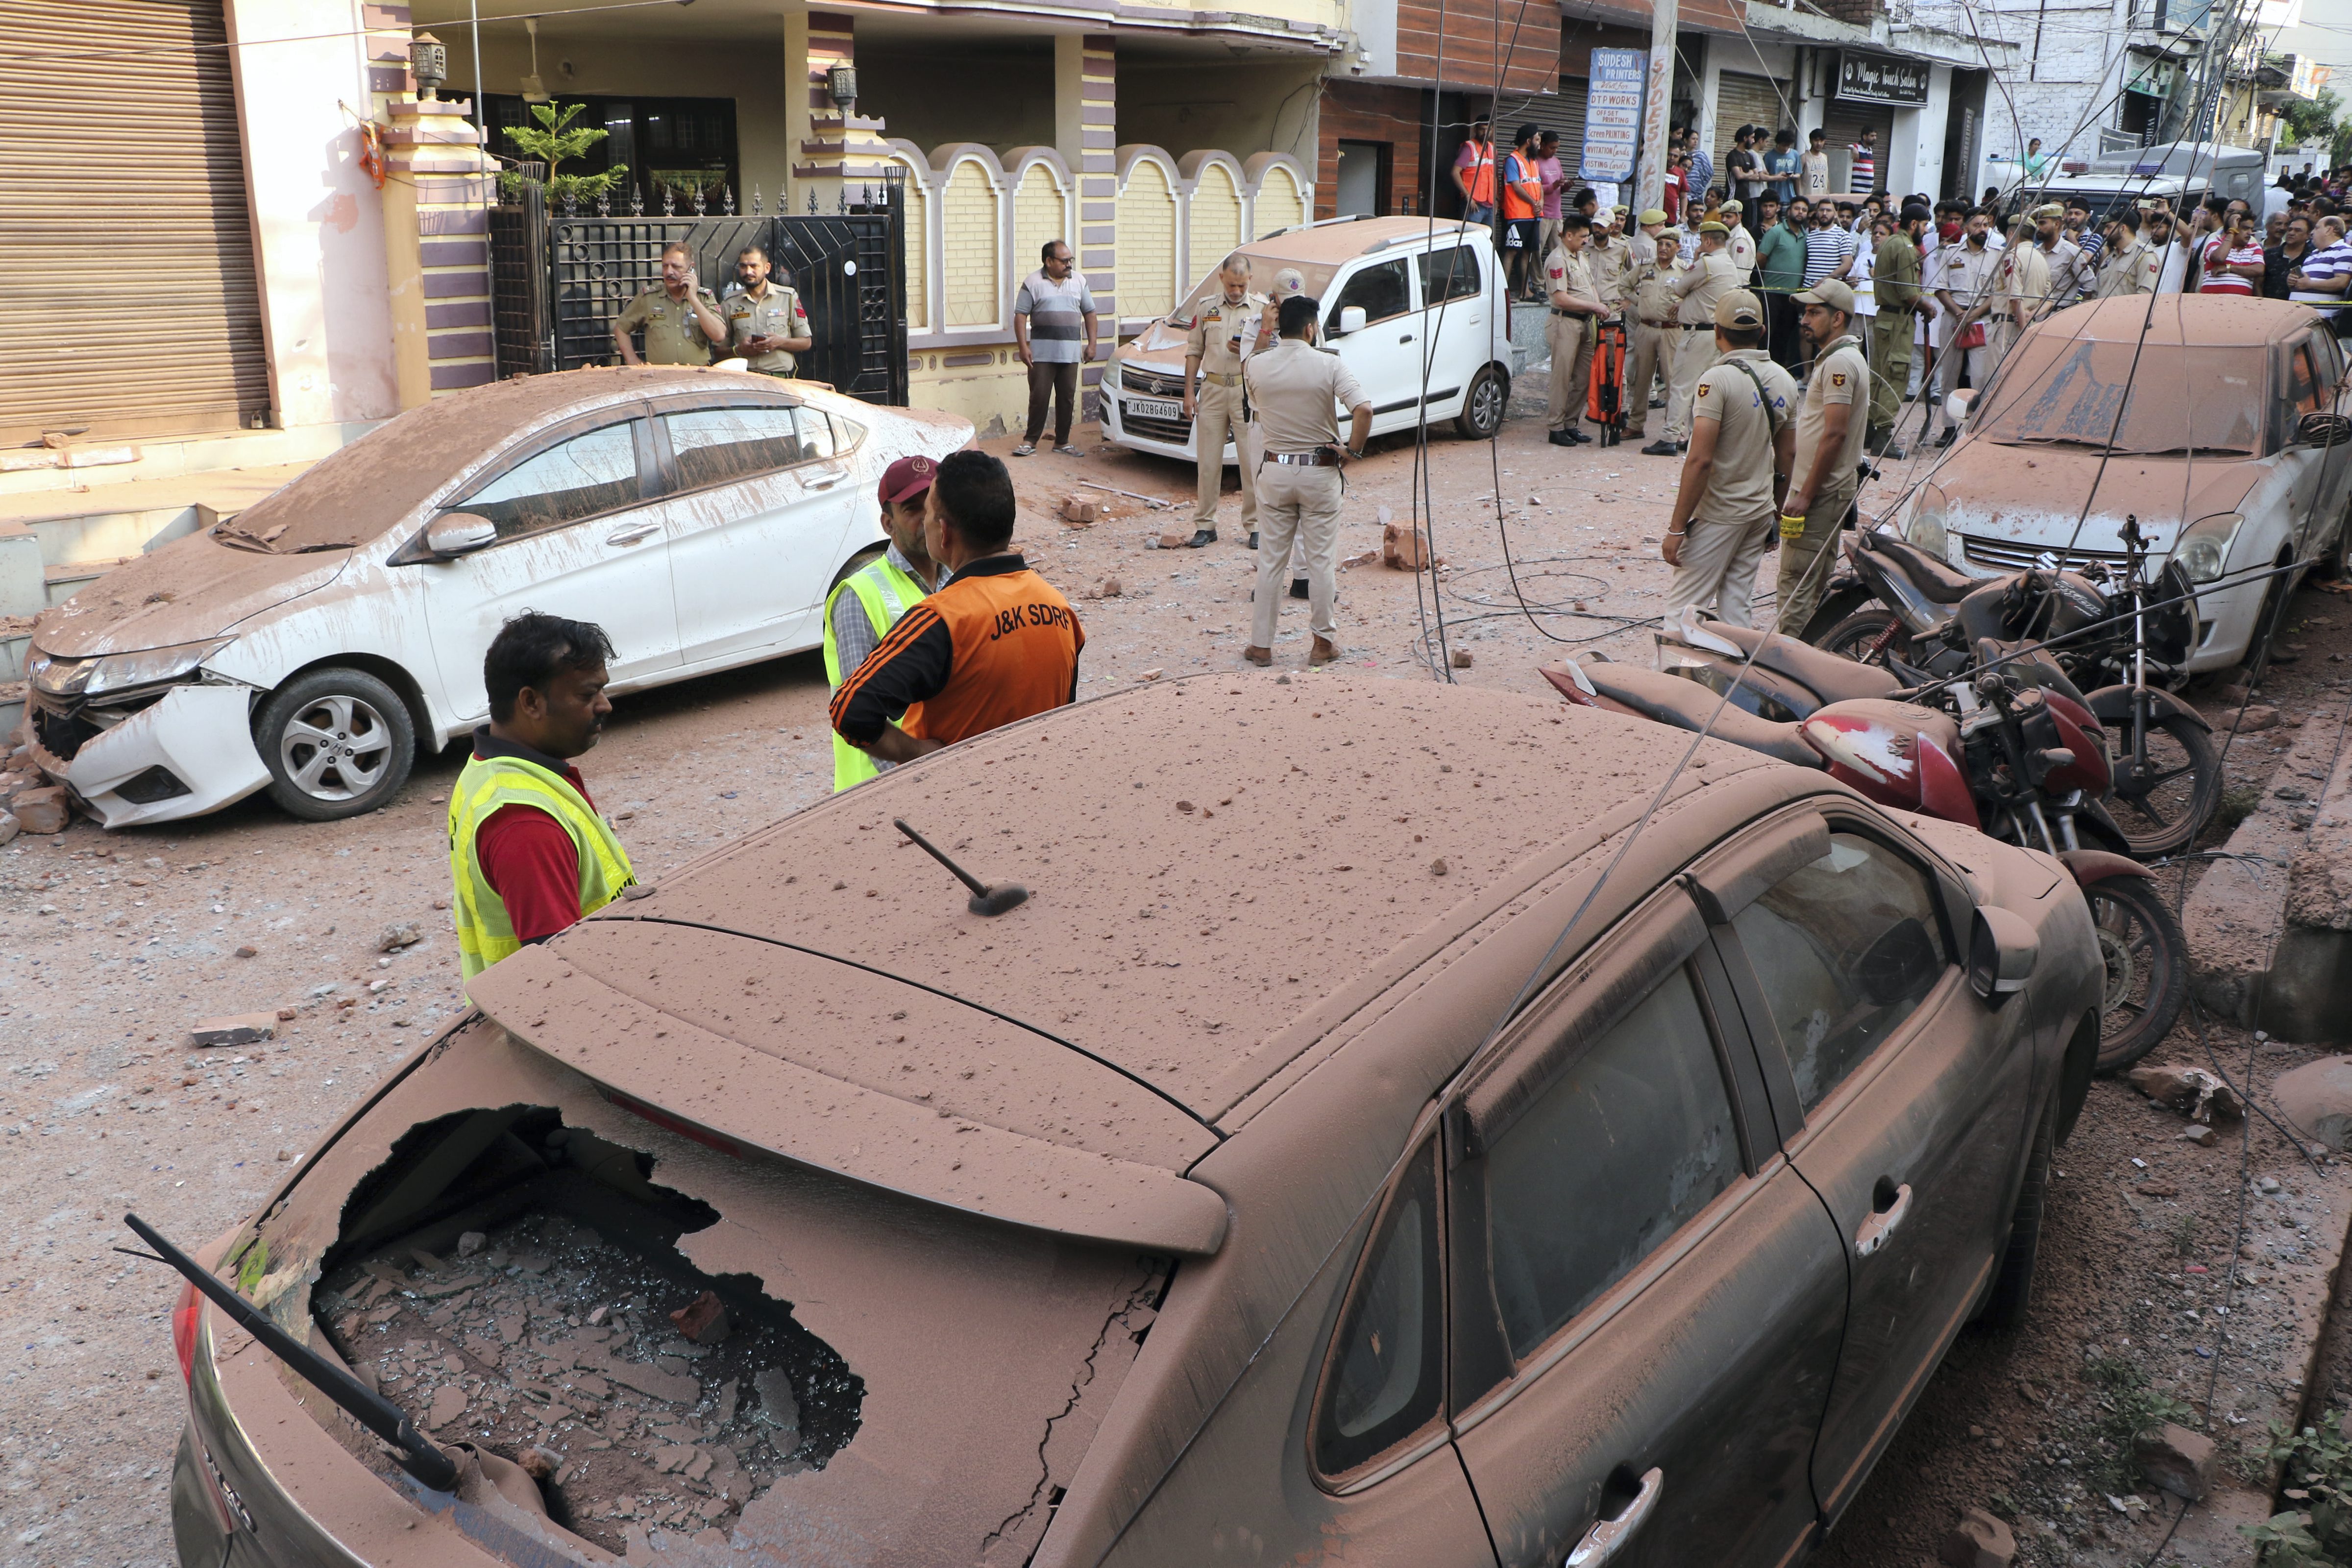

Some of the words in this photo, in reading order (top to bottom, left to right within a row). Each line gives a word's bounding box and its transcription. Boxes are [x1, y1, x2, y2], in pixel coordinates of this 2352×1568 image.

[1598, 54, 1632, 67] SUDESH
[1606, 69, 1642, 79] PRINTERS
[1857, 62, 1880, 91] Magic
[1882, 65, 1899, 86] Touch
[1900, 68, 1917, 88] Salon
[1591, 95, 1608, 104] DTP
[1609, 96, 1637, 105] WORKS
[1588, 129, 1605, 138] Screen
[1606, 130, 1630, 139] PRINTING
[1585, 145, 1613, 154] INVITATION
[1613, 145, 1629, 157] Cards
[1609, 160, 1627, 169] Cards
[1813, 174, 1824, 188] 24
[1132, 403, 1176, 417] JK02BG4609
[990, 605, 1027, 641] J&K
[1028, 603, 1070, 631] SDRF
